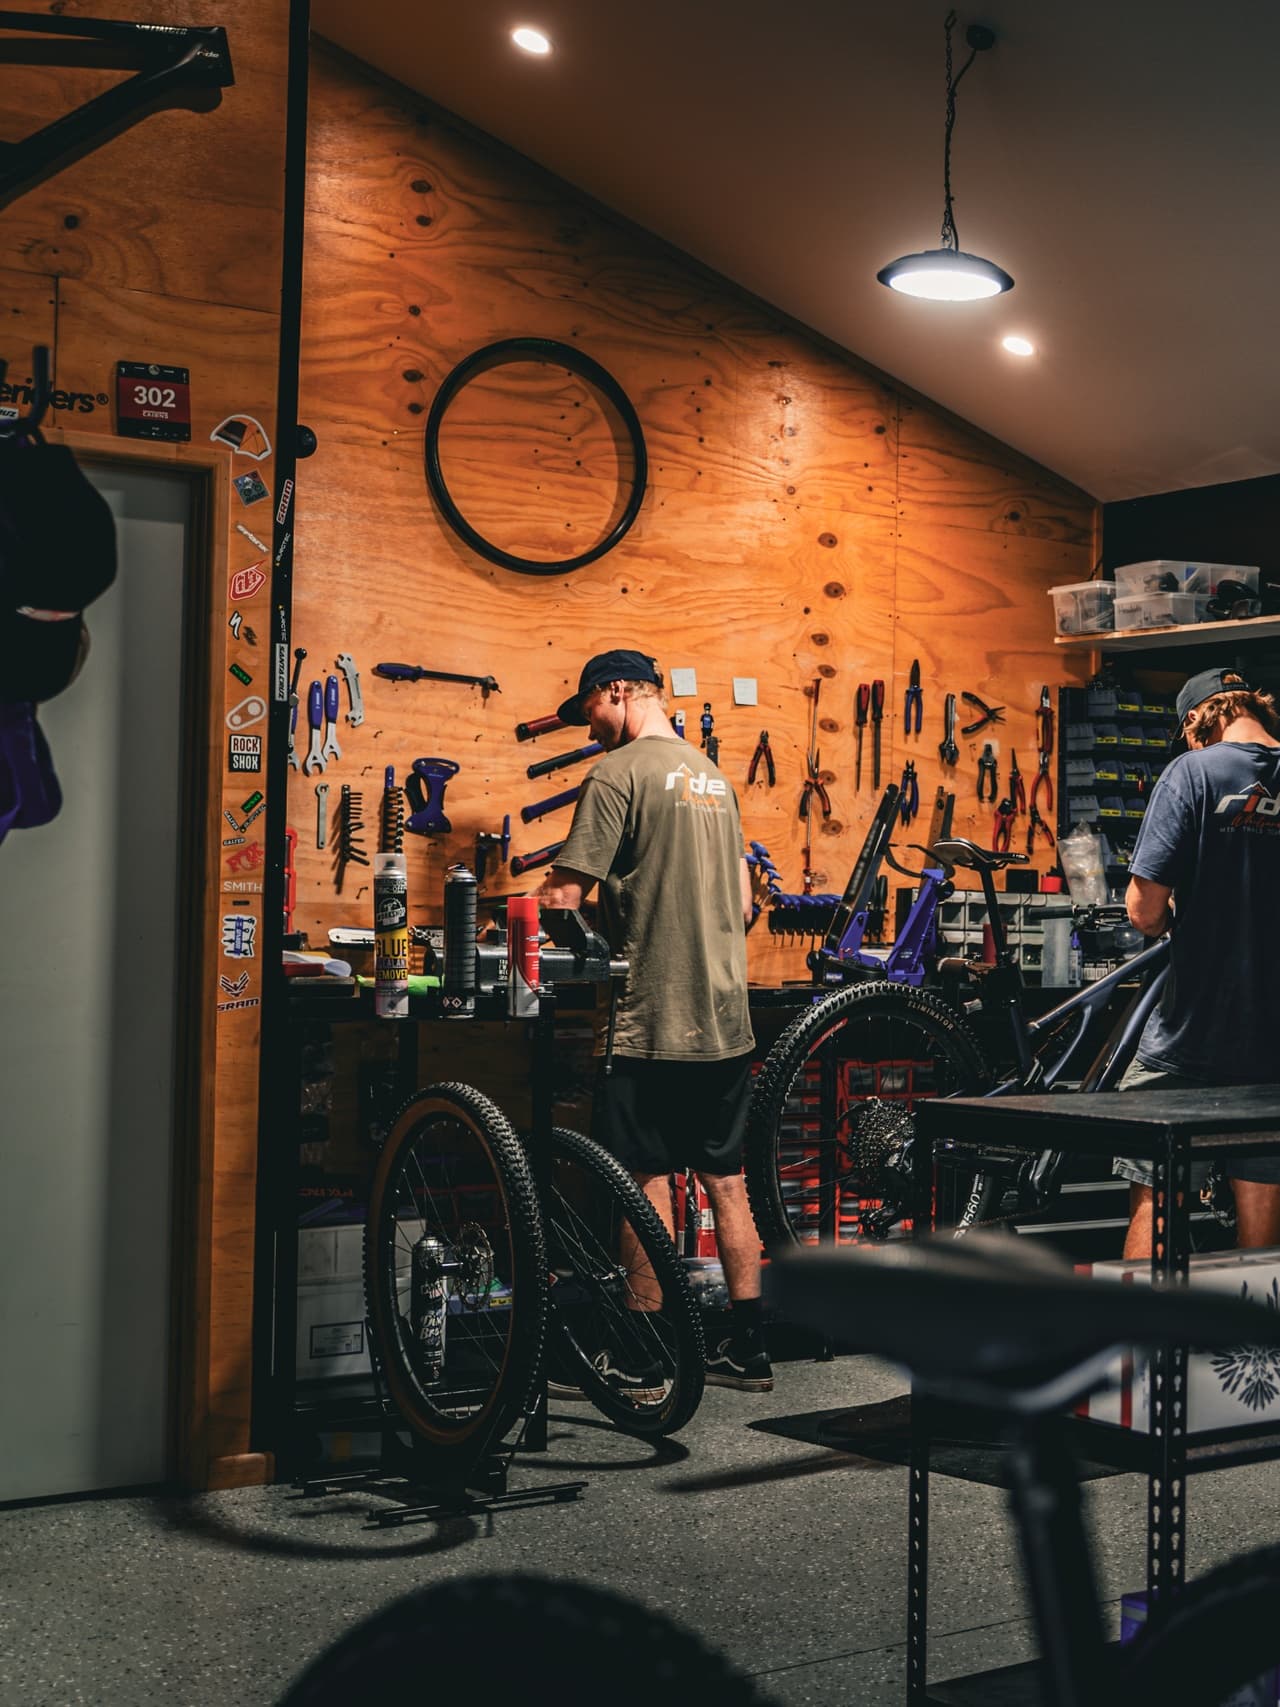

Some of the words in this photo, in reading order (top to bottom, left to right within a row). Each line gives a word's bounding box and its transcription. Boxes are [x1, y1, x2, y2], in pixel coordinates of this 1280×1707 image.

[134, 385, 176, 408] 302
[278, 480, 293, 523] SRAM
[233, 737, 259, 752] ROCK
[232, 754, 259, 770] SHOX
[223, 881, 263, 892] SMITH
[376, 938, 407, 957] GLUE
[217, 998, 260, 1011] SRAM
[906, 1001, 954, 1031] ELIMINATOR
